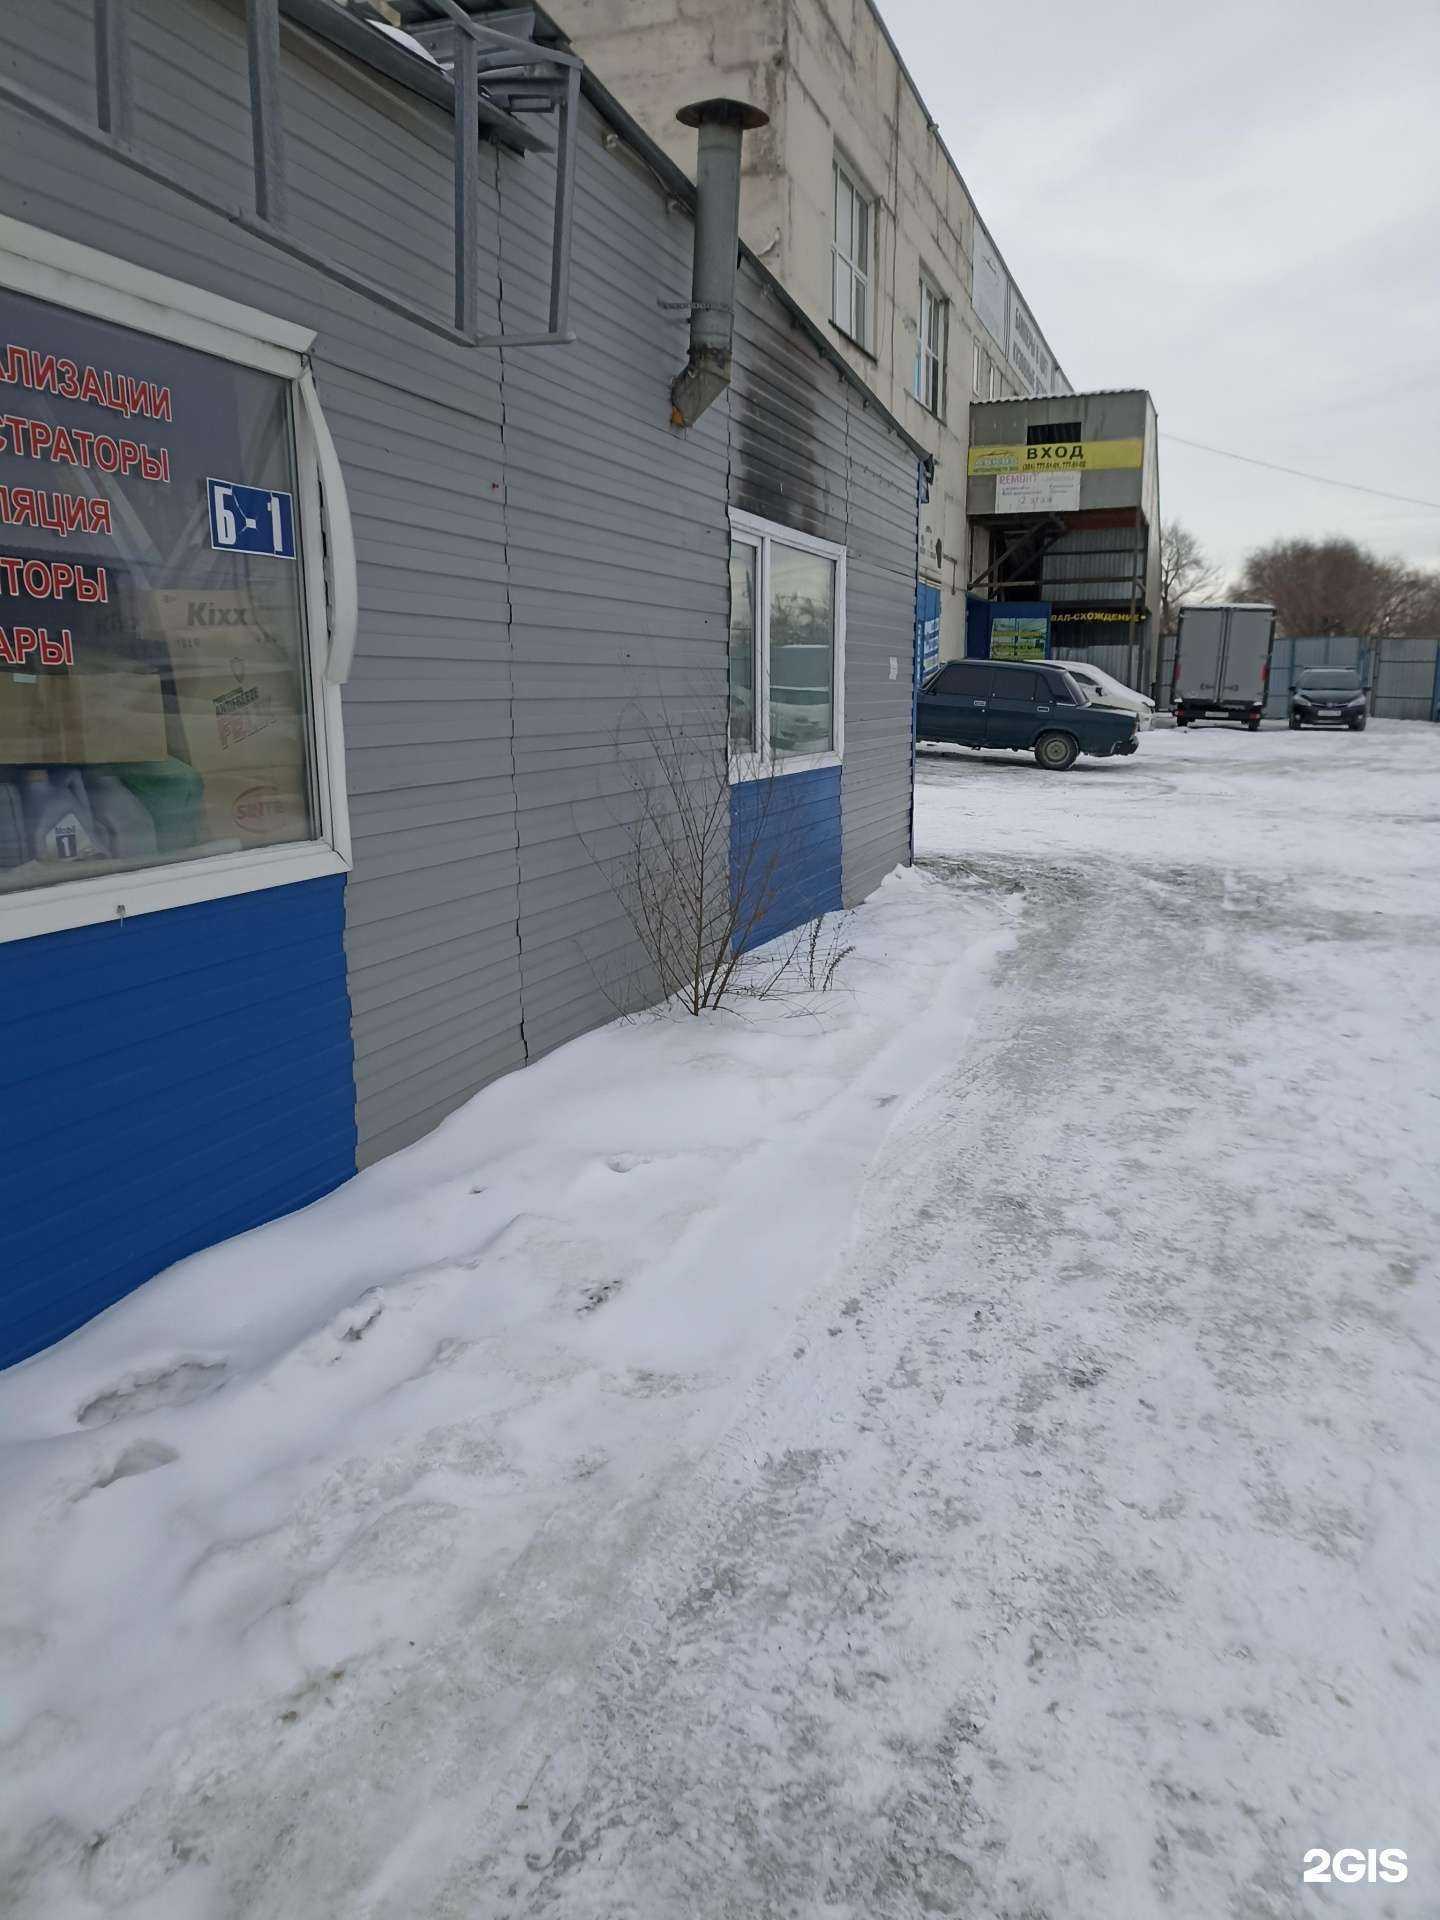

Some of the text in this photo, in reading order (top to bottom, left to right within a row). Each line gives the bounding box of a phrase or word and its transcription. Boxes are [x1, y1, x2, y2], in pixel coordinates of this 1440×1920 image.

[0, 344, 172, 422] ЛИЗАЦИИ
[1027, 446, 1084, 459] ВХОД
[214, 485, 283, 552] Б-1
[0, 557, 108, 603] ТОРЫ
[187, 602, 248, 626] Kixx
